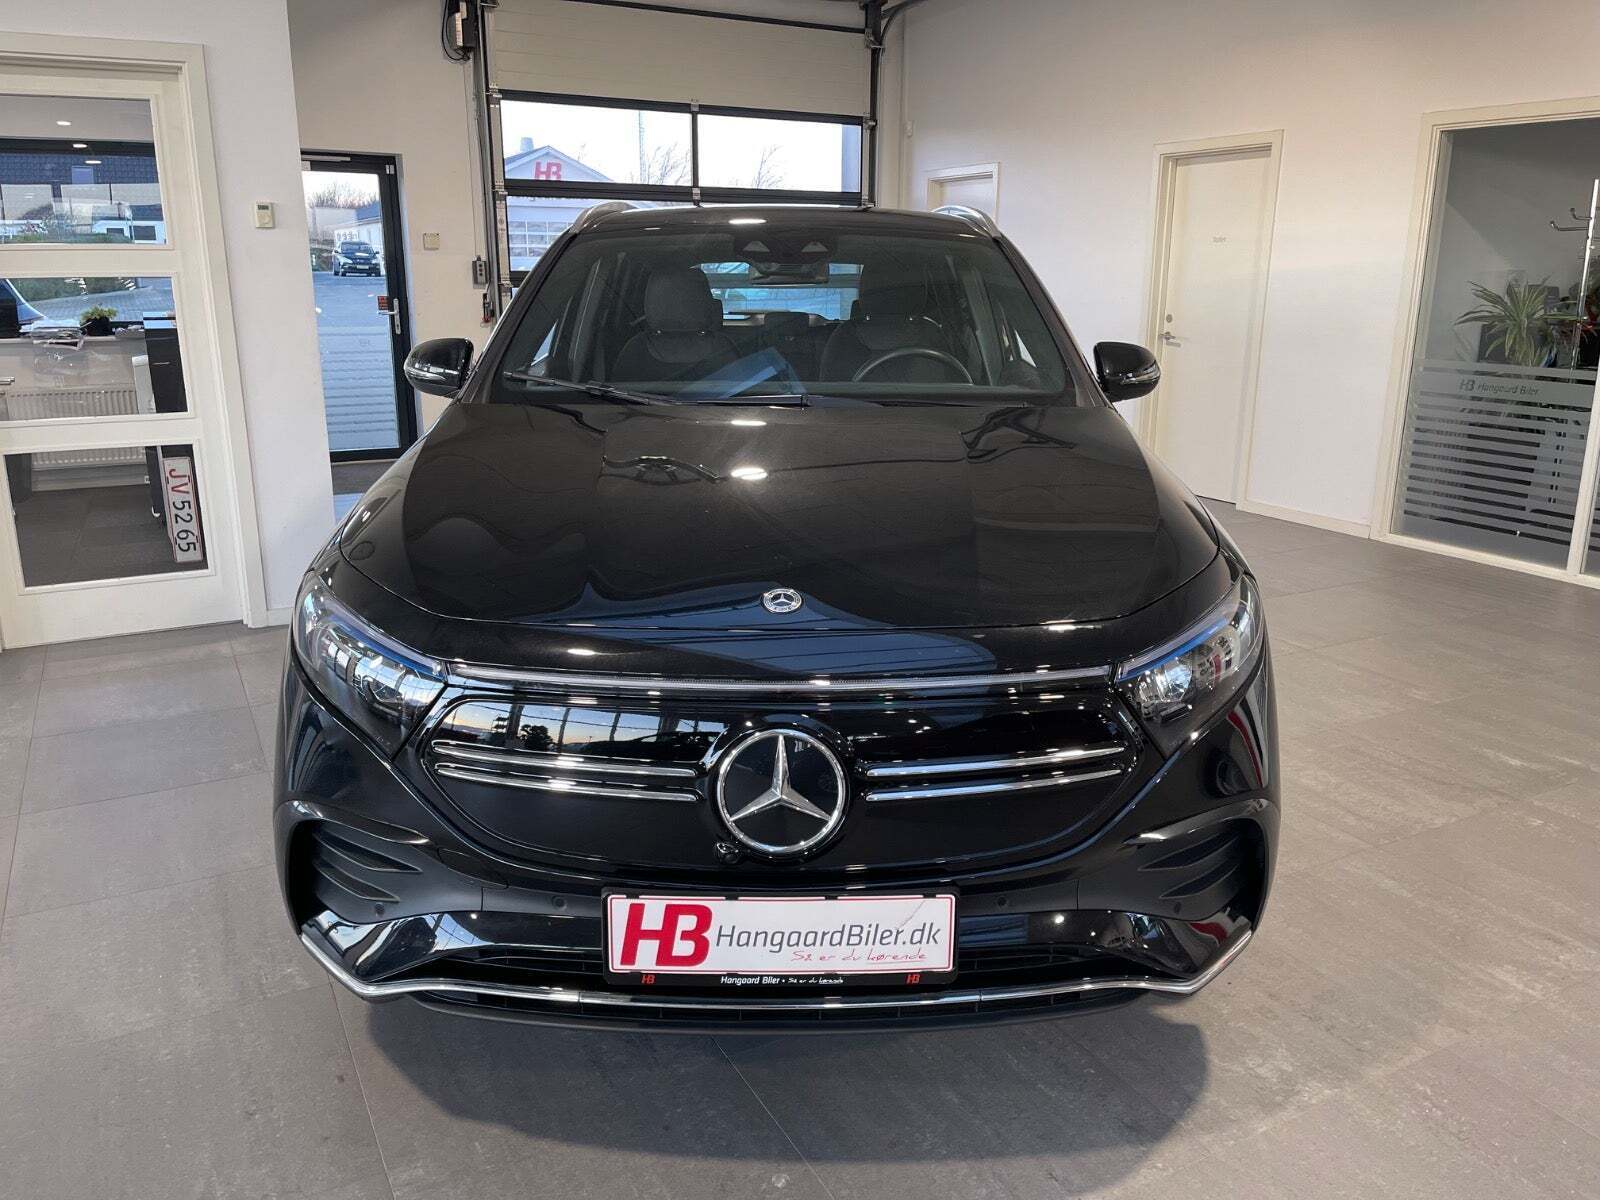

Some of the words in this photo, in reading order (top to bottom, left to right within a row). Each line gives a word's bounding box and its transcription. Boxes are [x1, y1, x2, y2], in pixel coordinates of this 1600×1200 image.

[169, 469, 190, 494] JV
[620, 903, 713, 966] HB
[716, 922, 941, 954] HangaardBiler.dk
[641, 975, 656, 984] HB
[720, 976, 760, 986] Hangaard
[762, 976, 780, 984] Biler
[906, 974, 920, 984] HB
